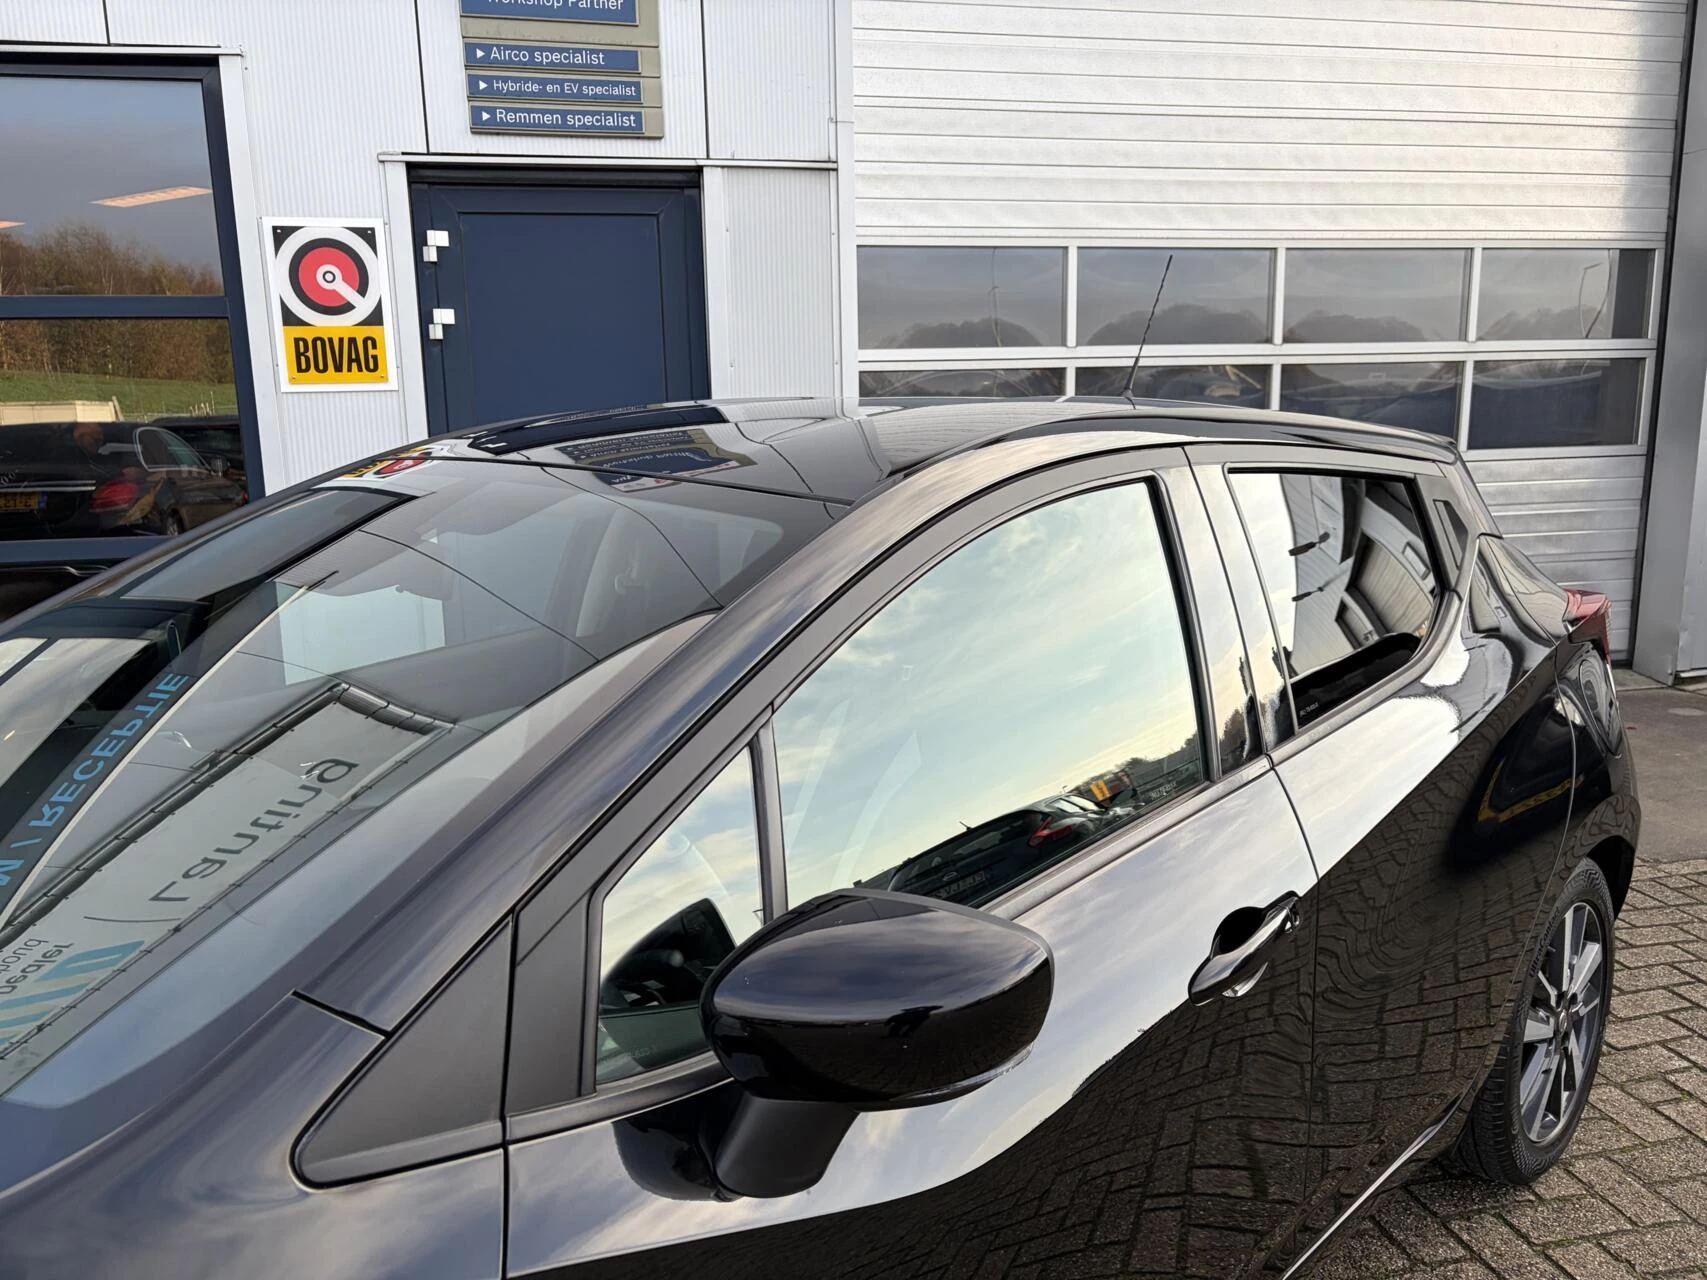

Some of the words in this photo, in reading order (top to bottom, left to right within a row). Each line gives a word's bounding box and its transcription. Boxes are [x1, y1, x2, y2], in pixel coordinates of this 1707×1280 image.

[490, 47, 529, 62] Airco
[534, 49, 605, 65] specialist
[493, 81, 543, 94] Hybride-
[547, 84, 561, 93] en
[564, 83, 579, 94] EV
[582, 84, 636, 96] specialist
[496, 109, 562, 125] Remmen
[566, 111, 636, 127] specialist
[293, 335, 380, 374] BOVAG
